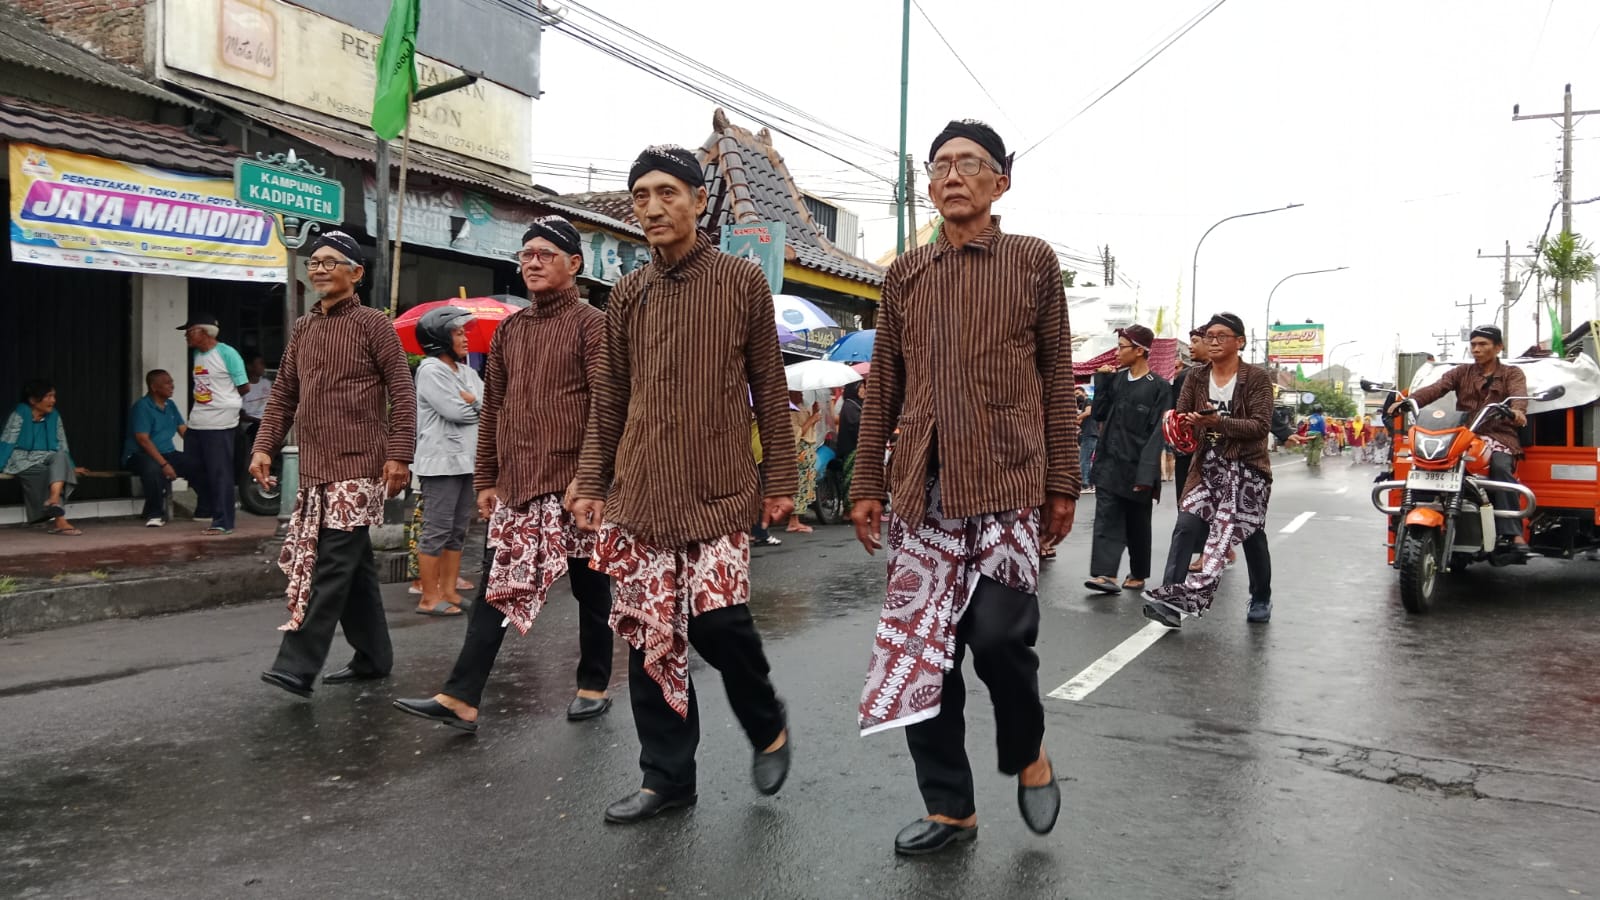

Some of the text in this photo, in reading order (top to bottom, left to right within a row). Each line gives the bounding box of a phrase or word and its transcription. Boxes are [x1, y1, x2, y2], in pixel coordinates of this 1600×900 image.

[260, 172, 322, 195] KAMPUNG
[148, 187, 178, 198] TOKO
[207, 196, 233, 207] FOTO
[250, 184, 332, 214] KADIPATEN
[32, 187, 265, 241] JAYA MANDIRI
